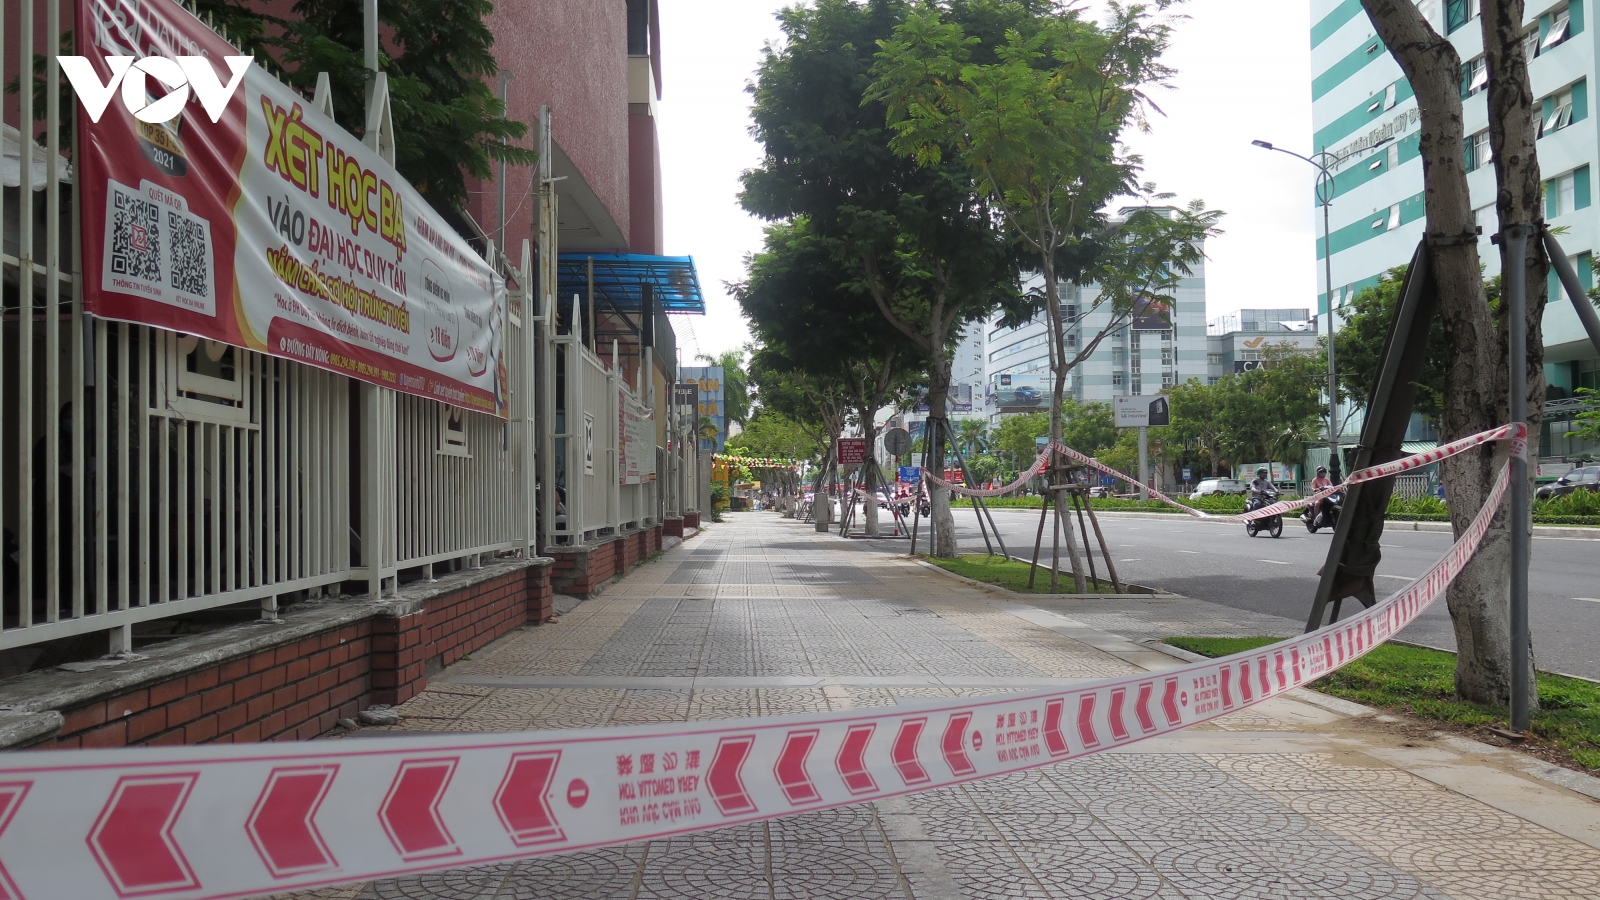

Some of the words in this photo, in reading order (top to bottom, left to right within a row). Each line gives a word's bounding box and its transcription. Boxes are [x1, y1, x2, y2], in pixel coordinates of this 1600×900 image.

[140, 121, 153, 138] TOP
[153, 148, 174, 170] 2021
[261, 94, 323, 199] XÉT
[326, 140, 377, 236] HỌC
[380, 179, 407, 262] BẠ
[148, 187, 161, 202] QUÉT
[164, 195, 173, 207] MÃ
[267, 194, 305, 246] VÀO
[308, 217, 334, 266] ĐẠI
[337, 232, 363, 278] HỌC
[364, 248, 386, 286] DUY
[388, 261, 408, 298] TÂN
[112, 279, 132, 289] THÔNG
[140, 283, 152, 294] TUYỂN
[267, 243, 300, 289] NẮM
[299, 259, 329, 301] CHẮC
[327, 274, 341, 307] CƠ
[341, 280, 359, 317] HỘI
[359, 289, 386, 325] TRÚNG
[387, 301, 410, 334] TUYỂN
[287, 337, 305, 358] ĐƯỜNG
[305, 343, 316, 360] DÂY
[315, 346, 329, 364] NÓNG:
